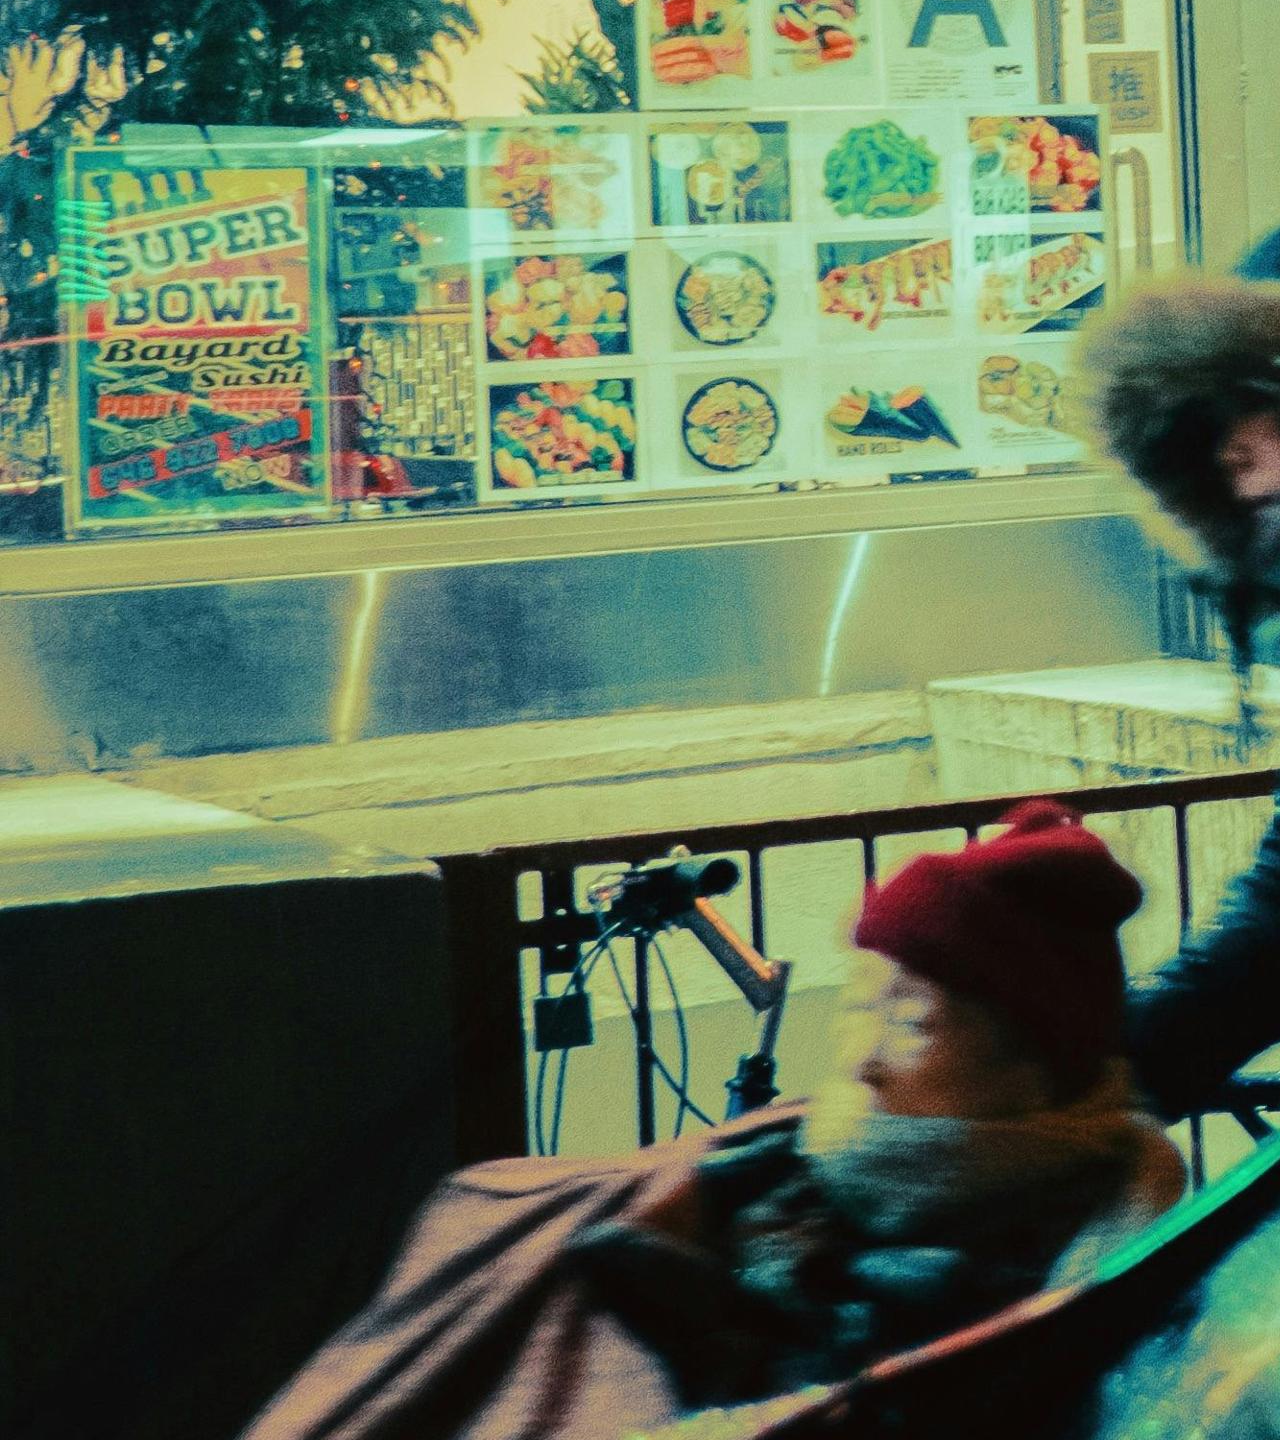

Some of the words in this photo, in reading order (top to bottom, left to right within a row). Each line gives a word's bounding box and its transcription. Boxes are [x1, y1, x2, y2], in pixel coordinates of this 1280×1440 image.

[94, 205, 302, 280] SUPER
[113, 280, 294, 326] BOWL
[102, 333, 291, 367] Bayard
[195, 364, 305, 388] Sushi
